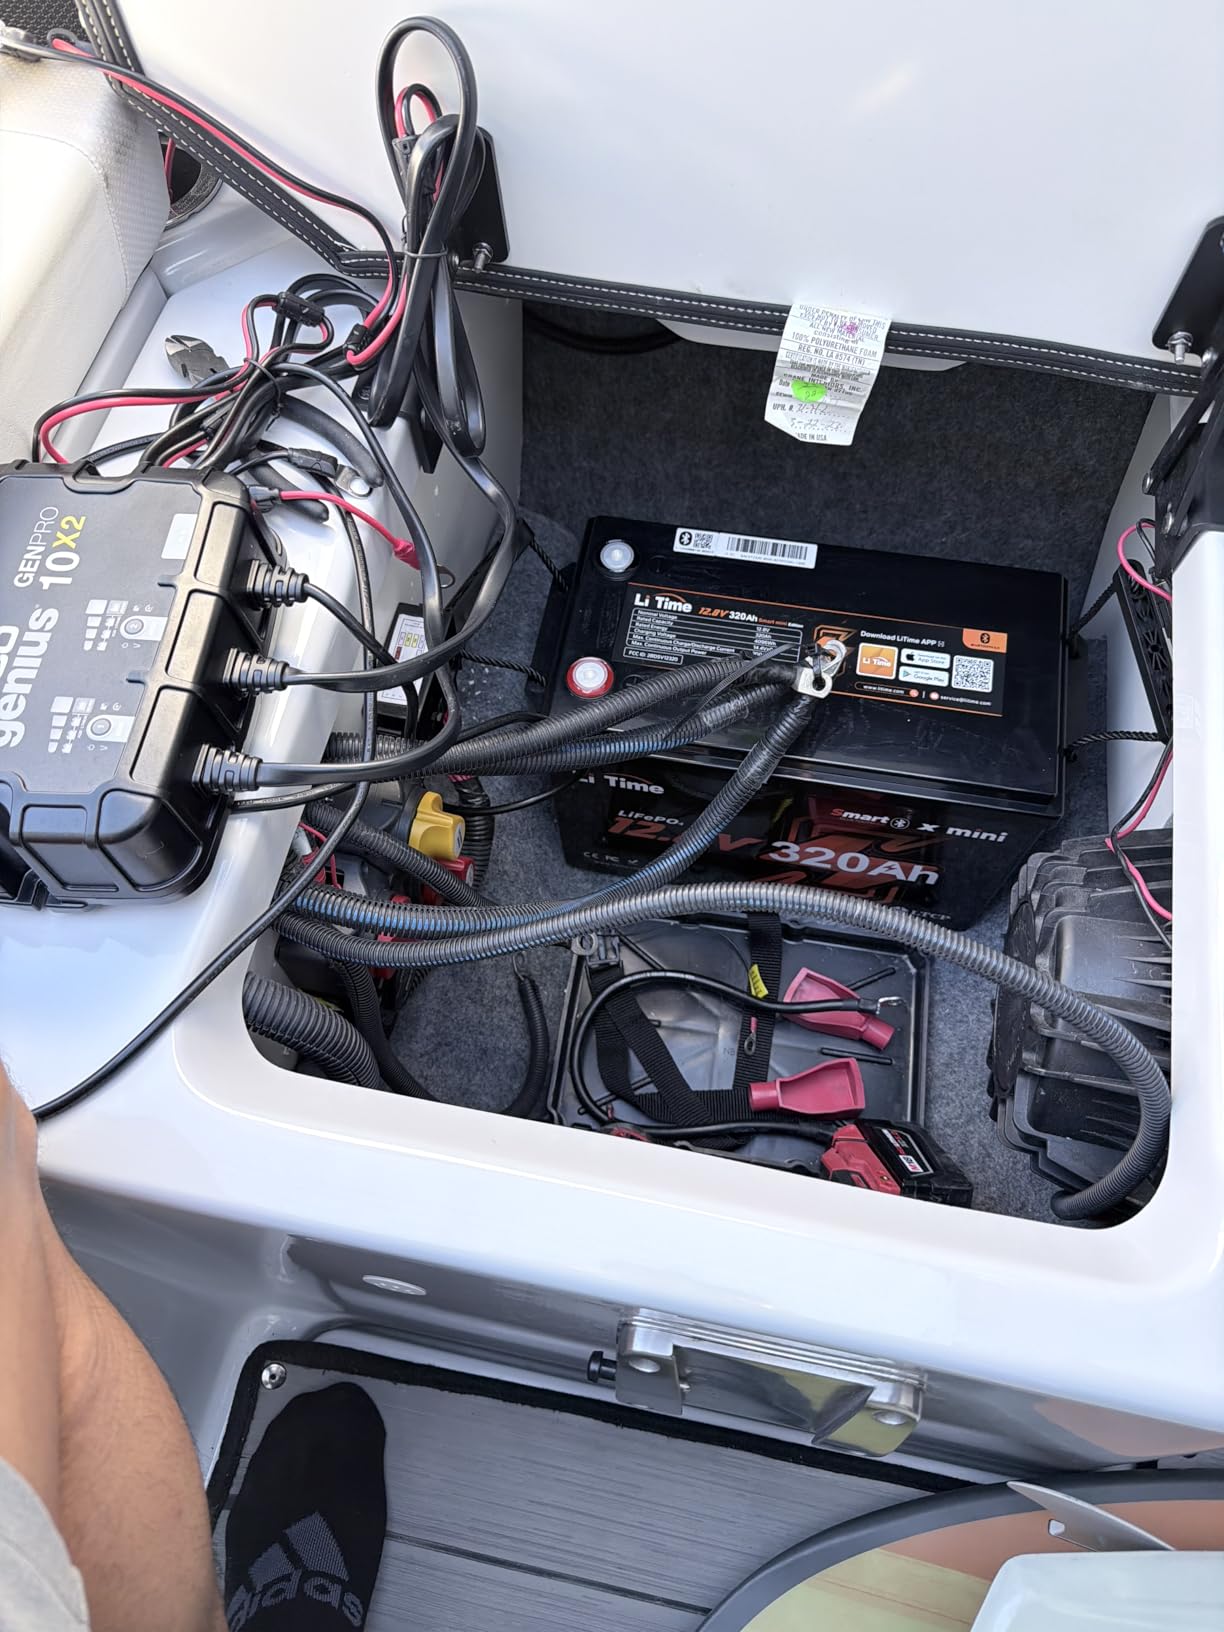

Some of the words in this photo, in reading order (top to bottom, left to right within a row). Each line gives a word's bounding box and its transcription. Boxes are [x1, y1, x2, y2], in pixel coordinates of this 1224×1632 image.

[792, 331, 809, 343] 100%
[811, 336, 858, 354] POLYURETHANE
[860, 348, 877, 357] FOAM
[798, 344, 812, 353] REG.
[814, 347, 824, 356] NO.
[852, 355, 865, 366] (TN)
[14, 506, 60, 588] GENPRO
[39, 515, 86, 591] 10X2
[634, 593, 650, 607] Li
[655, 596, 693, 613] Time
[698, 607, 729, 618] 12.8V
[729, 610, 758, 622] 320Ah
[634, 628, 656, 636] Charging
[652, 618, 673, 626] Capacity
[644, 642, 672, 650] Continuous
[645, 636, 672, 644] Continuous
[860, 630, 895, 641] Download
[896, 636, 920, 644] LiTime
[872, 658, 891, 667] Time
[0, 606, 60, 749] genius
[603, 775, 664, 794] Time
[830, 808, 890, 825] Smart
[945, 826, 1009, 843] mini
[768, 840, 941, 885] 320Ah
